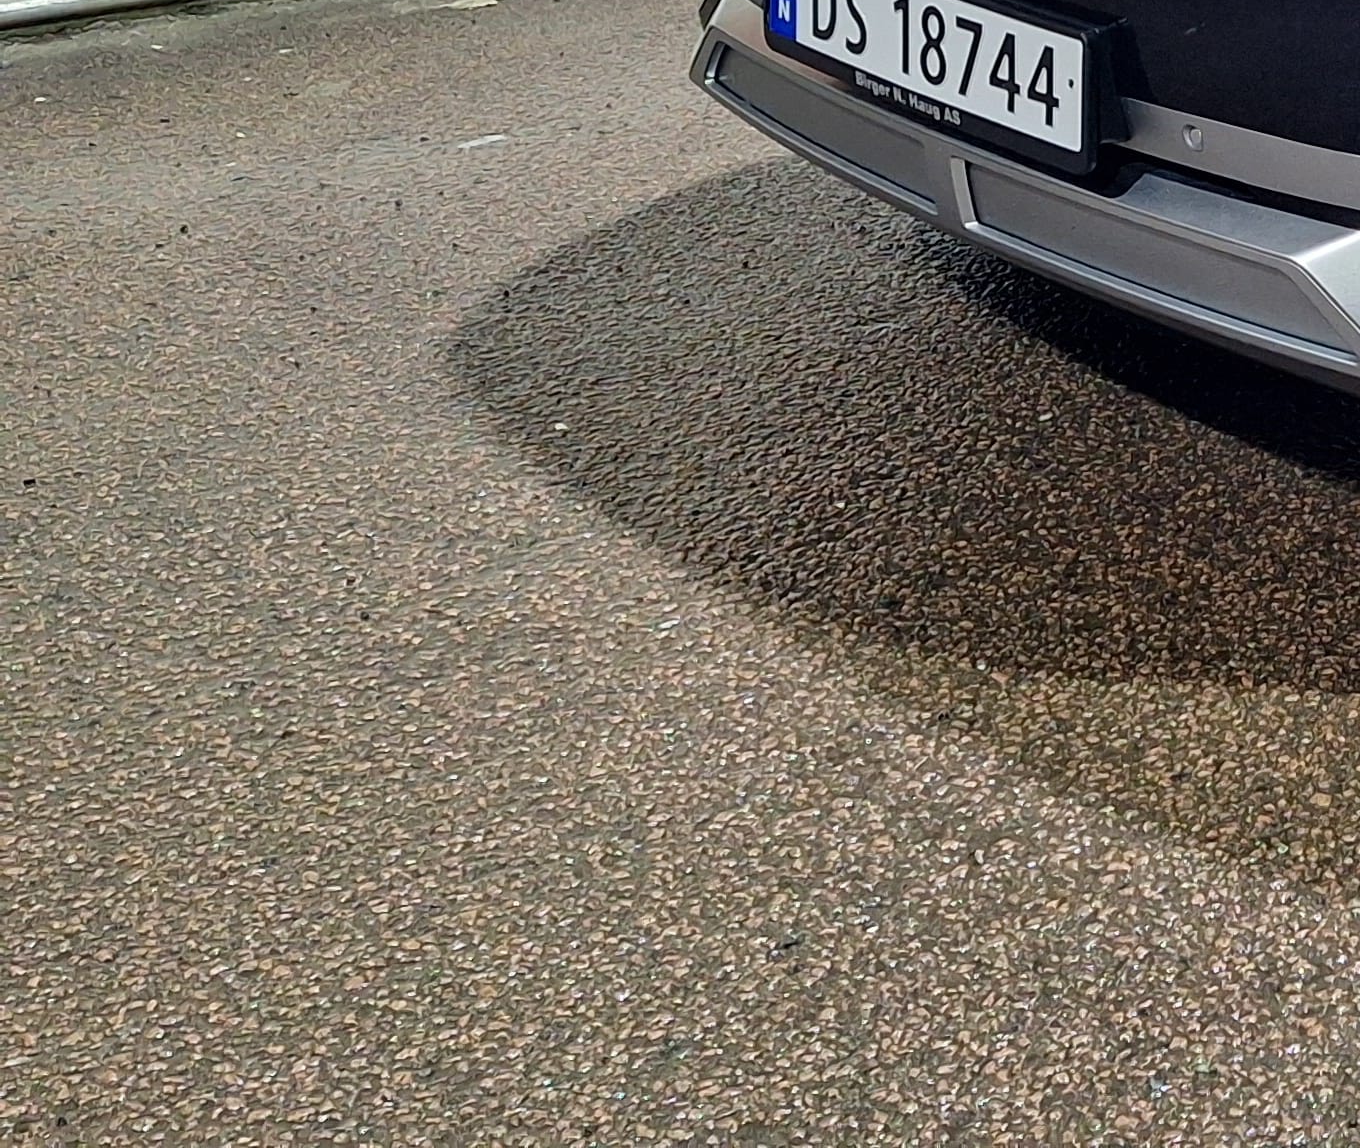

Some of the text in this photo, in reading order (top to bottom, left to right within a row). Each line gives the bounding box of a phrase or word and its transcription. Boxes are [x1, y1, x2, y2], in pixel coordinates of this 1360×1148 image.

[855, 70, 891, 98] Birger
[908, 93, 941, 121] Haug
[943, 106, 961, 126] AS
